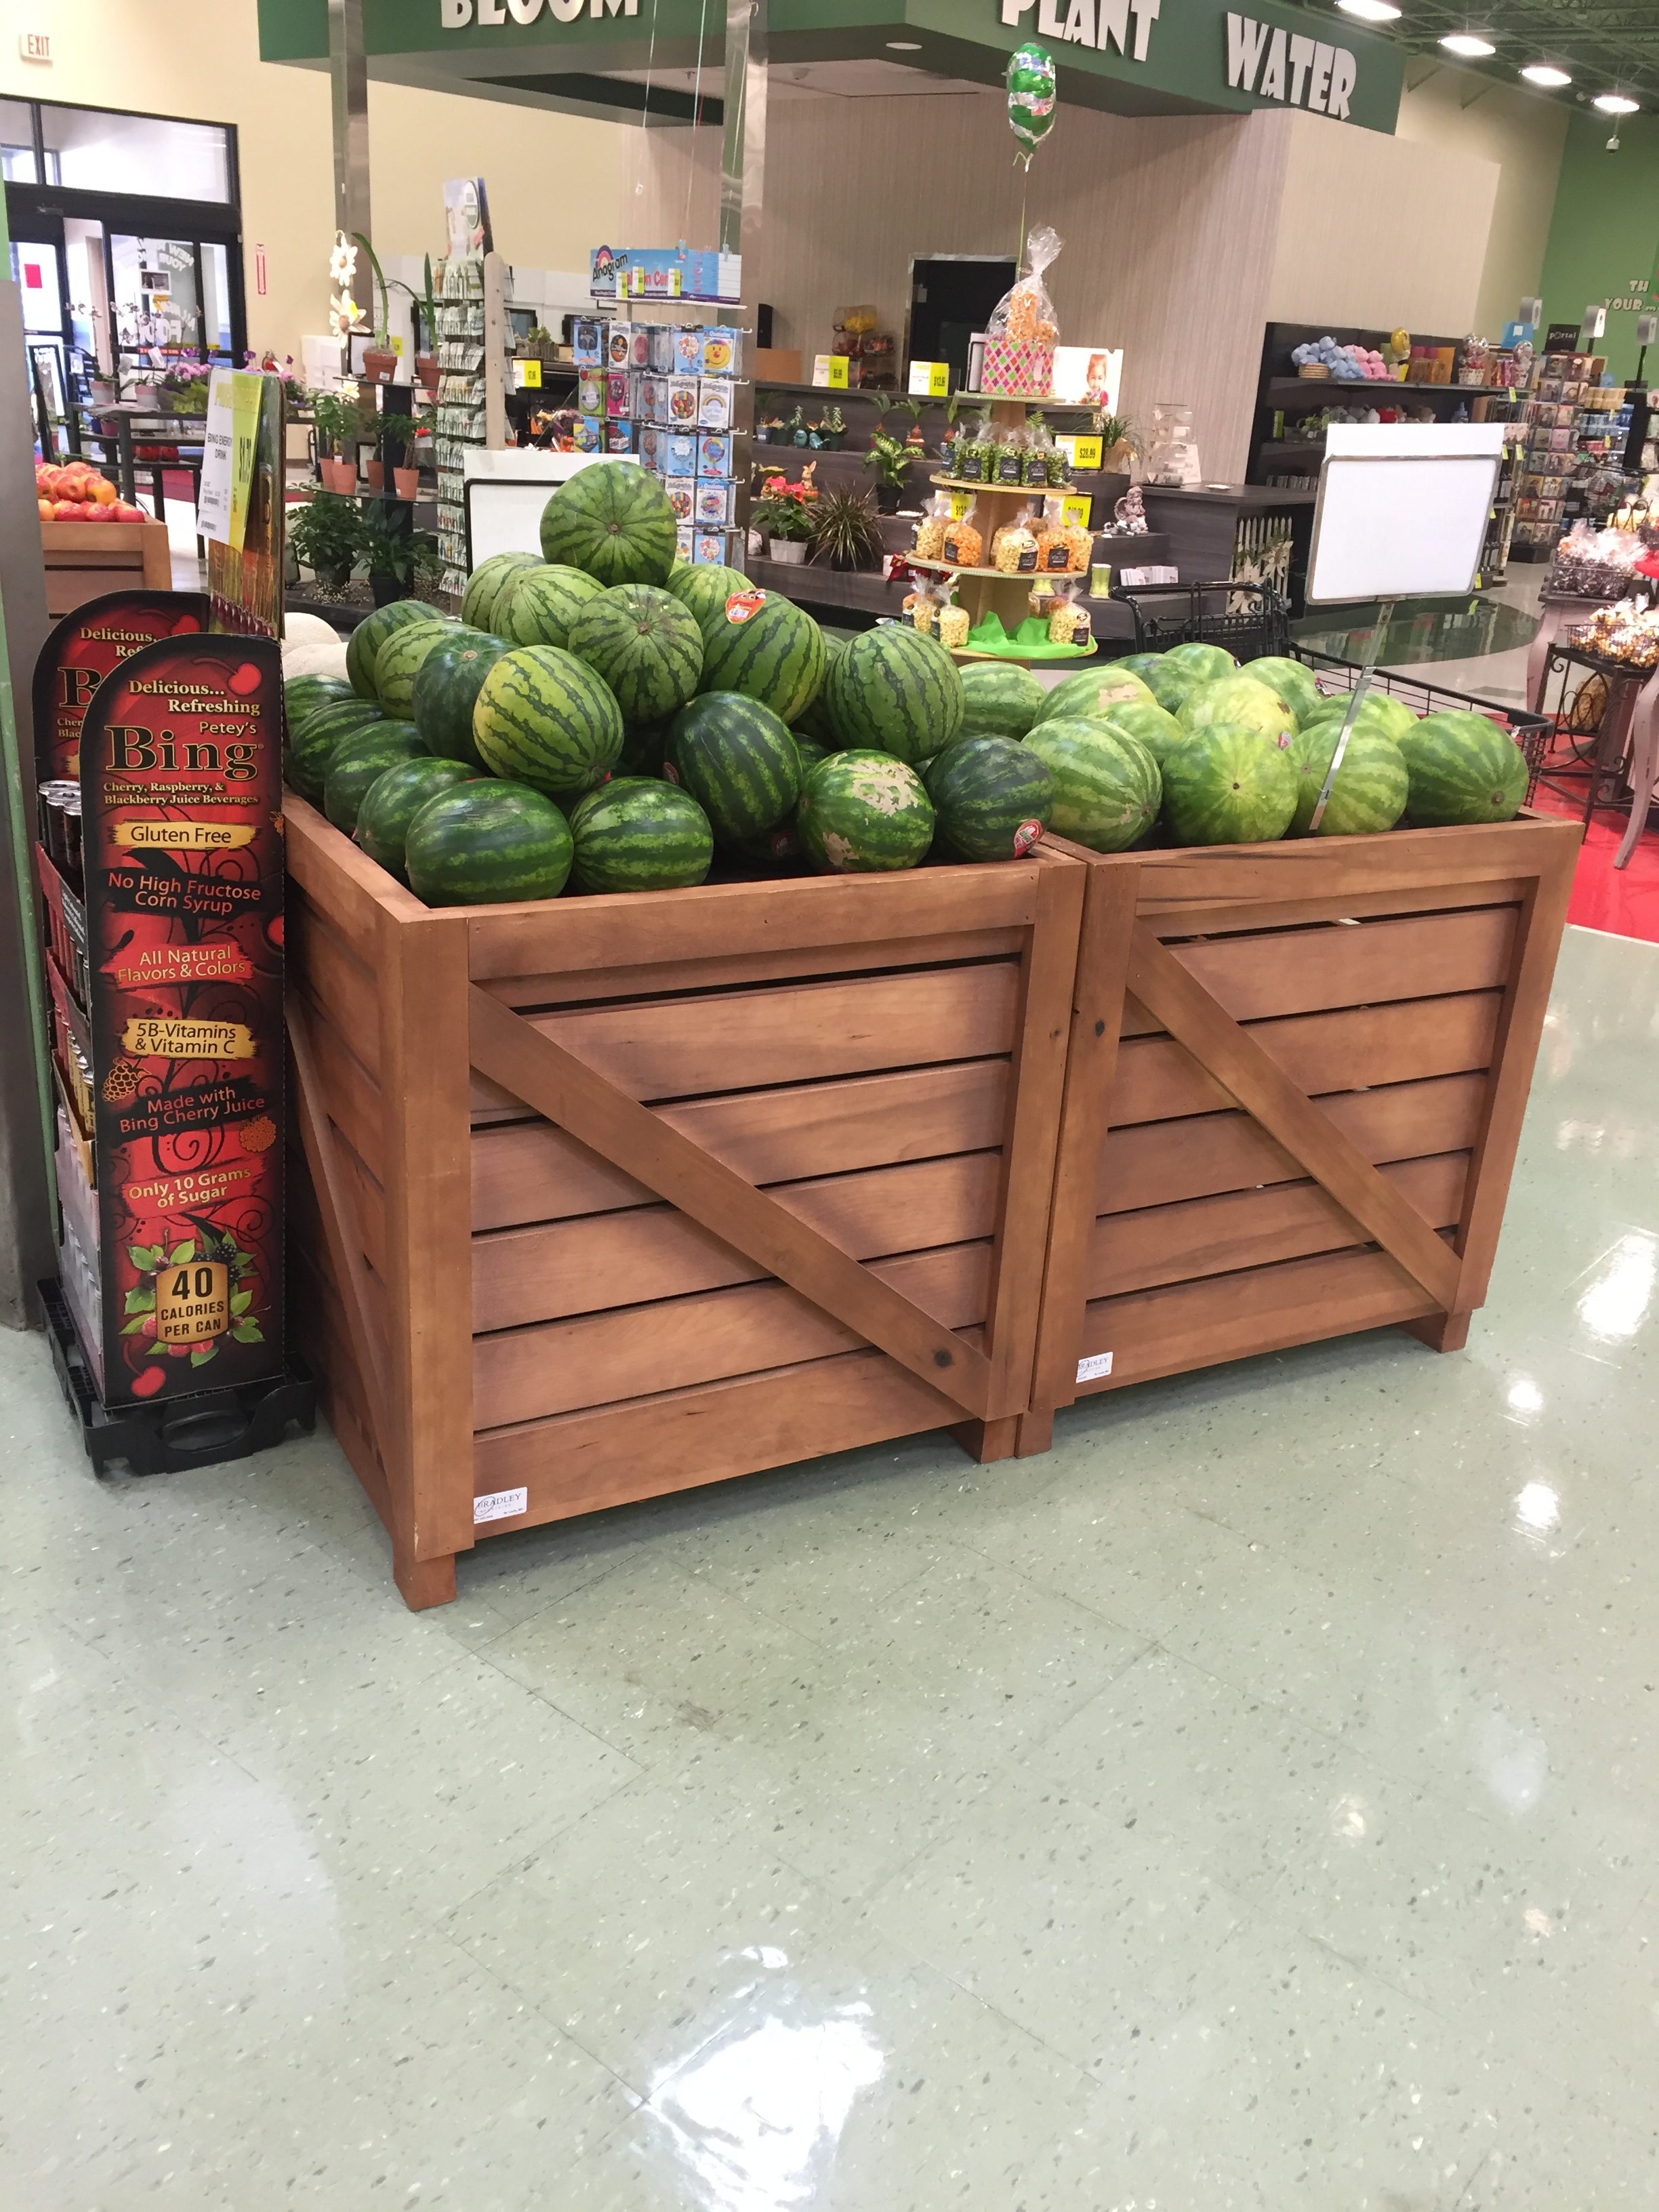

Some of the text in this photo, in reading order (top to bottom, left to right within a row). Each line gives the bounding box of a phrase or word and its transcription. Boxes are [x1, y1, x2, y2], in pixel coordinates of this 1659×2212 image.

[28, 34, 49, 56] EXIT
[1227, 12, 1356, 119] WATER
[592, 253, 628, 282] Anagram
[1604, 298, 1643, 310] YOUR
[207, 433, 218, 444] BING
[215, 448, 227, 460] DRINK
[80, 628, 160, 642] Delicious.
[129, 680, 224, 695] Delicious...
[168, 699, 260, 716] Refreshing
[199, 721, 258, 737] Petey's
[104, 725, 260, 781] Bing
[104, 782, 225, 794] Cherry, Raspberry, &
[104, 795, 259, 806] Blackberry Juice Beverages
[131, 826, 232, 843] Gluten Free
[108, 872, 261, 901] No High Fructose
[136, 891, 233, 915] Corn Syrup
[140, 945, 231, 966] All Natural
[118, 960, 245, 983] Flavors & Colors
[136, 1038, 236, 1054] & Vitamin C
[147, 1086, 237, 1113] Made with
[120, 1097, 265, 1133] Bing Cherry Juice
[129, 1166, 251, 1200] Only 10 Grams
[157, 1185, 228, 1208] of Sugar
[172, 1267, 213, 1300] 40
[161, 1301, 224, 1321] CALORIES
[165, 1319, 222, 1338] PER CAN
[477, 1493, 521, 1508] BRADLEY
